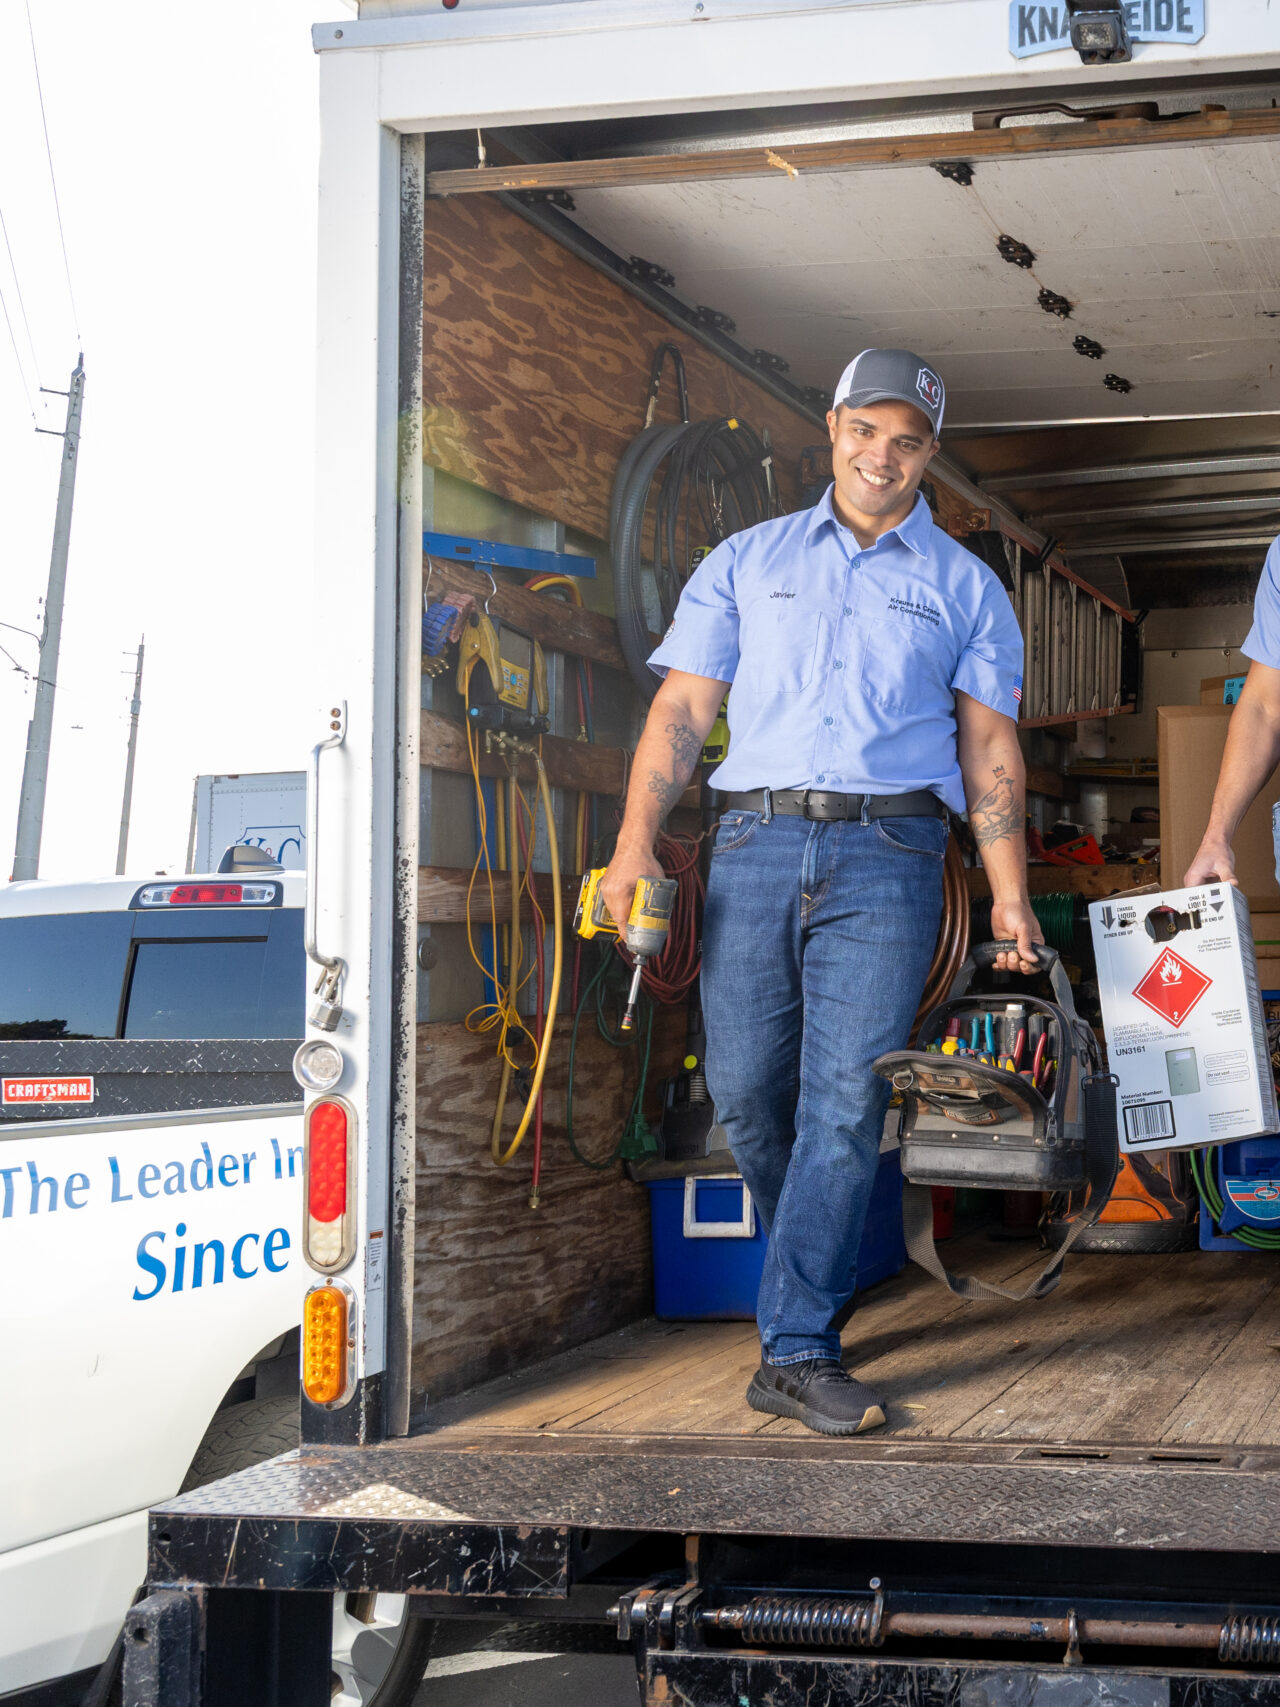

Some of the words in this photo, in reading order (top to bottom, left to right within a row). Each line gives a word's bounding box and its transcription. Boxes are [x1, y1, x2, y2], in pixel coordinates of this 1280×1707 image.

[1018, 0, 1194, 48] KNAEIDE
[769, 591, 796, 599] Javier
[888, 603, 898, 611] Air
[899, 606, 940, 626] Conditioning
[890, 597, 914, 608] Krauss
[922, 605, 941, 618] Crane
[1117, 911, 1137, 920] LIQUID
[1173, 1011, 1179, 1020] 2
[1115, 1045, 1146, 1056] UN3161
[1120, 1092, 1142, 1100] Material
[0, 1160, 91, 1219] The
[107, 1141, 257, 1203] Leader
[132, 1222, 291, 1301] Since
